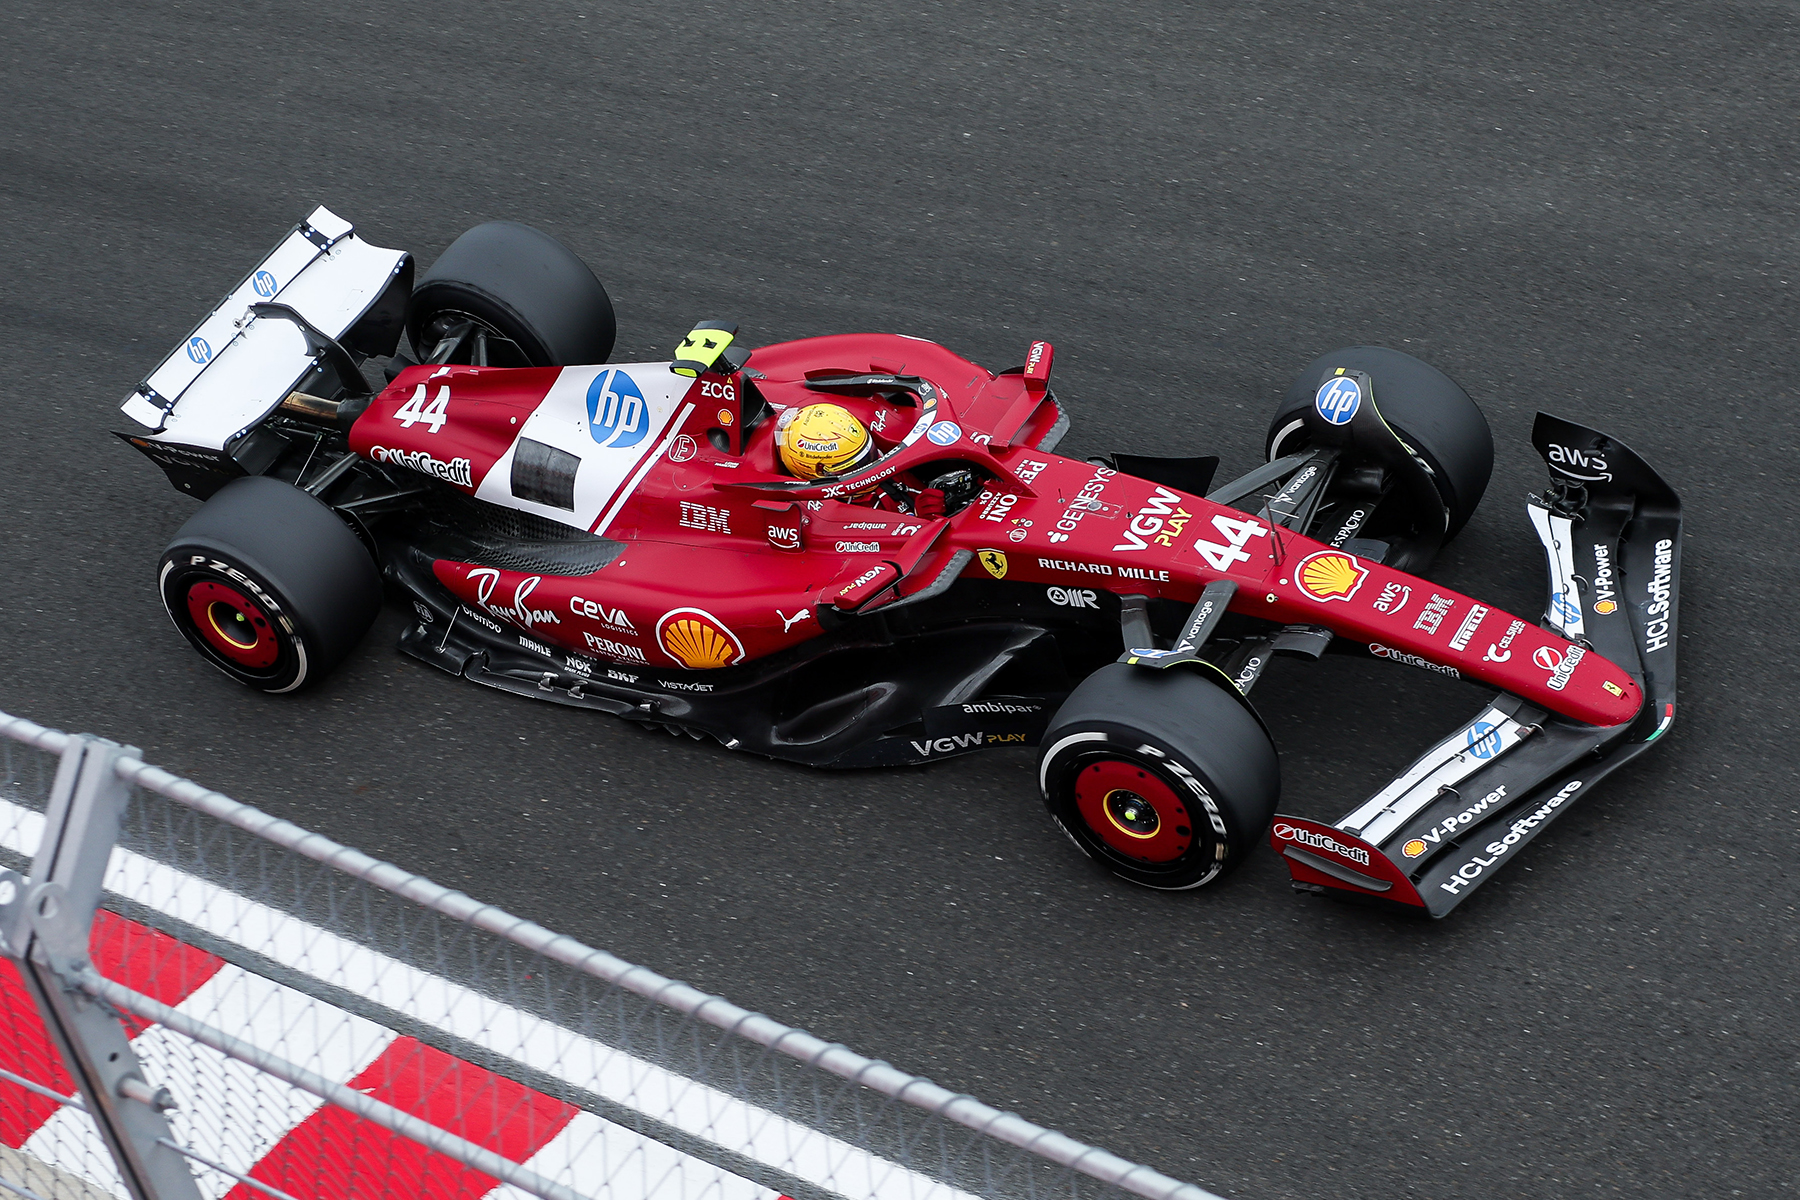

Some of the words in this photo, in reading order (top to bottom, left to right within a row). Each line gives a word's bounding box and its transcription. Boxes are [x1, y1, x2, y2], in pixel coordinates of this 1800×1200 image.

[252, 270, 277, 297] hp
[187, 337, 212, 363] hp
[1030, 341, 1045, 363] VGW
[393, 383, 450, 433] 44
[589, 369, 648, 448] hp
[1315, 376, 1362, 425] hp
[804, 442, 838, 451] UniCredit
[927, 421, 962, 446] hp
[388, 448, 473, 487] UniCredit
[1549, 443, 1607, 470] aws
[845, 466, 896, 491] TECHNOLOGY
[1286, 466, 1317, 494] vantage
[1056, 467, 1117, 531] GENESYS
[679, 500, 732, 534] IBM
[1112, 486, 1182, 551] VGW
[1154, 507, 1193, 547] PLAY
[768, 525, 798, 541] aws
[844, 542, 880, 552] UniCredit
[1193, 514, 1268, 572] 44
[190, 555, 206, 565] P
[209, 559, 282, 611] ZERO
[855, 566, 886, 587] VGW
[1038, 558, 1112, 575] RICHARD
[1118, 566, 1170, 582] MILLE
[1594, 544, 1614, 600] V-Power
[1373, 582, 1402, 612] aws
[1647, 538, 1673, 653] HCLSoftware
[461, 603, 502, 634] brembo
[601, 622, 639, 636] LOGISTICS
[1187, 601, 1213, 639] vantage
[1413, 593, 1455, 635] IBM
[1448, 604, 1489, 651] PIRELLI
[518, 635, 551, 657] MAHLE
[583, 631, 647, 661] PERONI
[1499, 620, 1522, 649] CELSIUS
[566, 655, 592, 673] NGK
[607, 669, 639, 683] SKF
[1388, 648, 1460, 679] UniCredit
[1547, 645, 1586, 690] UniCredit
[910, 732, 983, 756] VGW
[986, 733, 1026, 743] PLAY
[1467, 721, 1501, 759] hp
[1136, 744, 1165, 758] P
[1162, 759, 1227, 838] ZERO
[1422, 784, 1508, 844] V-Power
[1295, 828, 1369, 865] UniCredit
[1440, 780, 1583, 894] HCLSoftware
